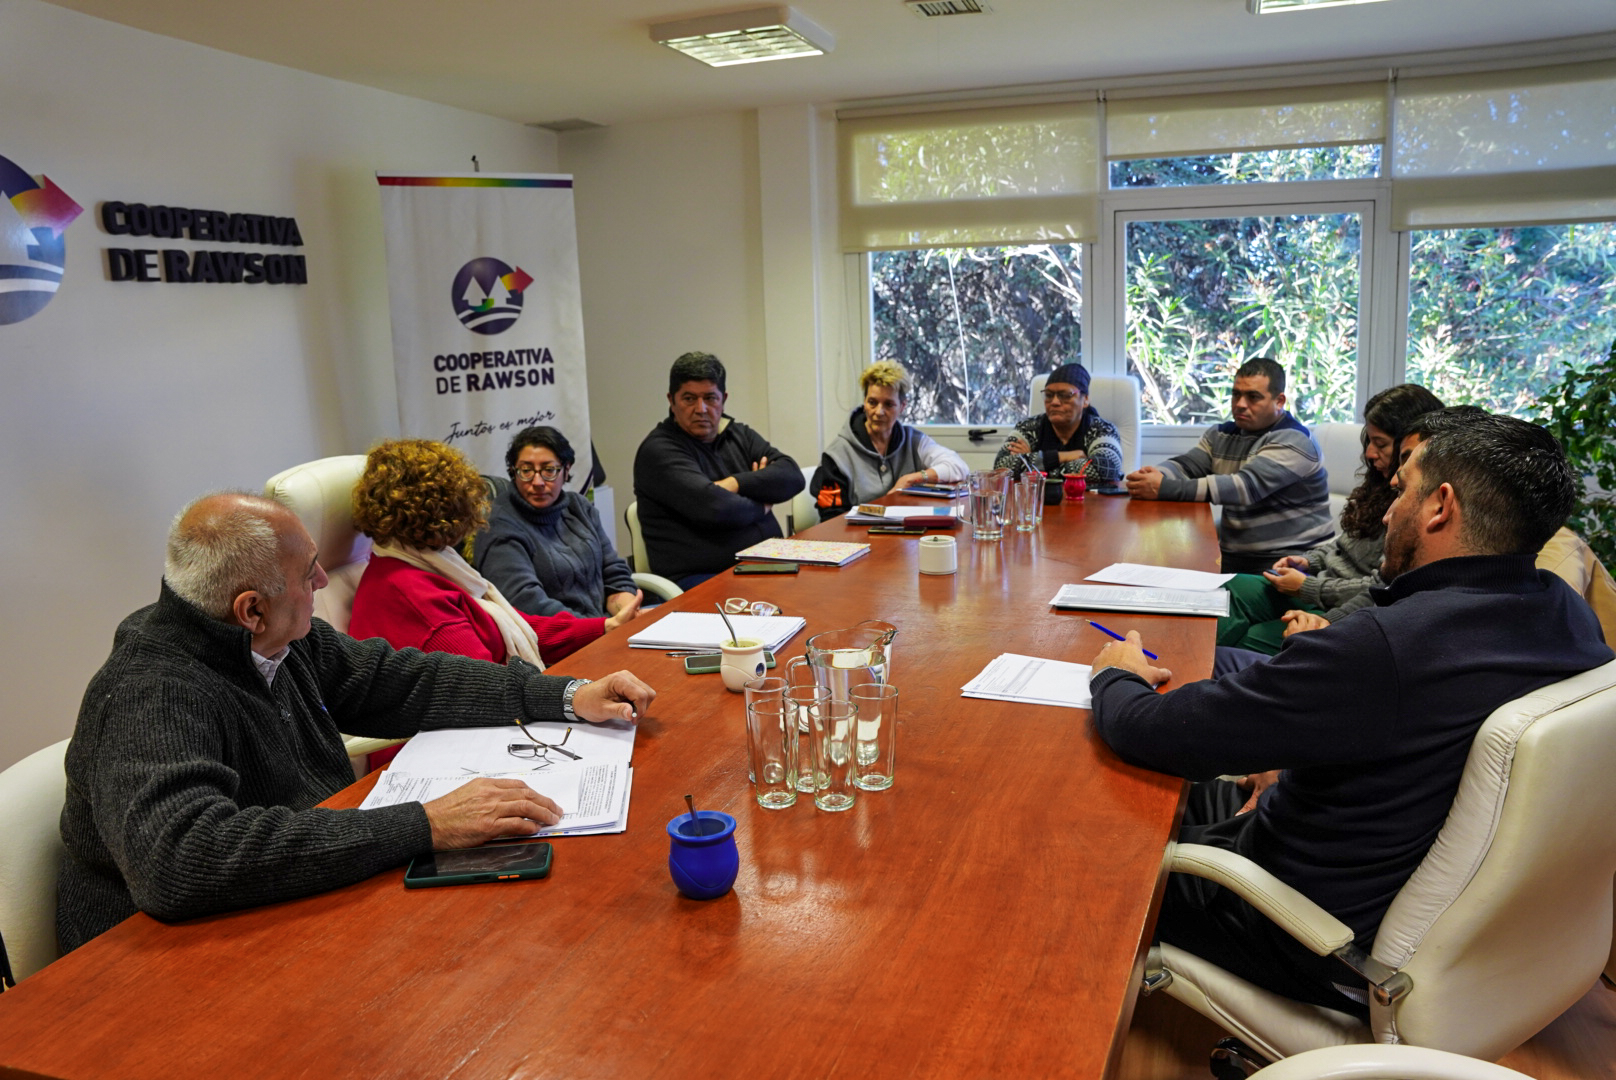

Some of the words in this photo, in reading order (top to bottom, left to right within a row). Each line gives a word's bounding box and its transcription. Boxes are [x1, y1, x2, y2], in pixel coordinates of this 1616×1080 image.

[102, 201, 304, 246] COOPERATIVA
[108, 248, 161, 282] DE
[163, 249, 308, 284] RAWSON
[434, 347, 554, 372] COOPERATIVA
[436, 375, 461, 395] DE
[466, 367, 555, 392] RAWSON
[443, 421, 495, 445] Juntos
[499, 421, 513, 431] es
[516, 411, 555, 428] mejor
